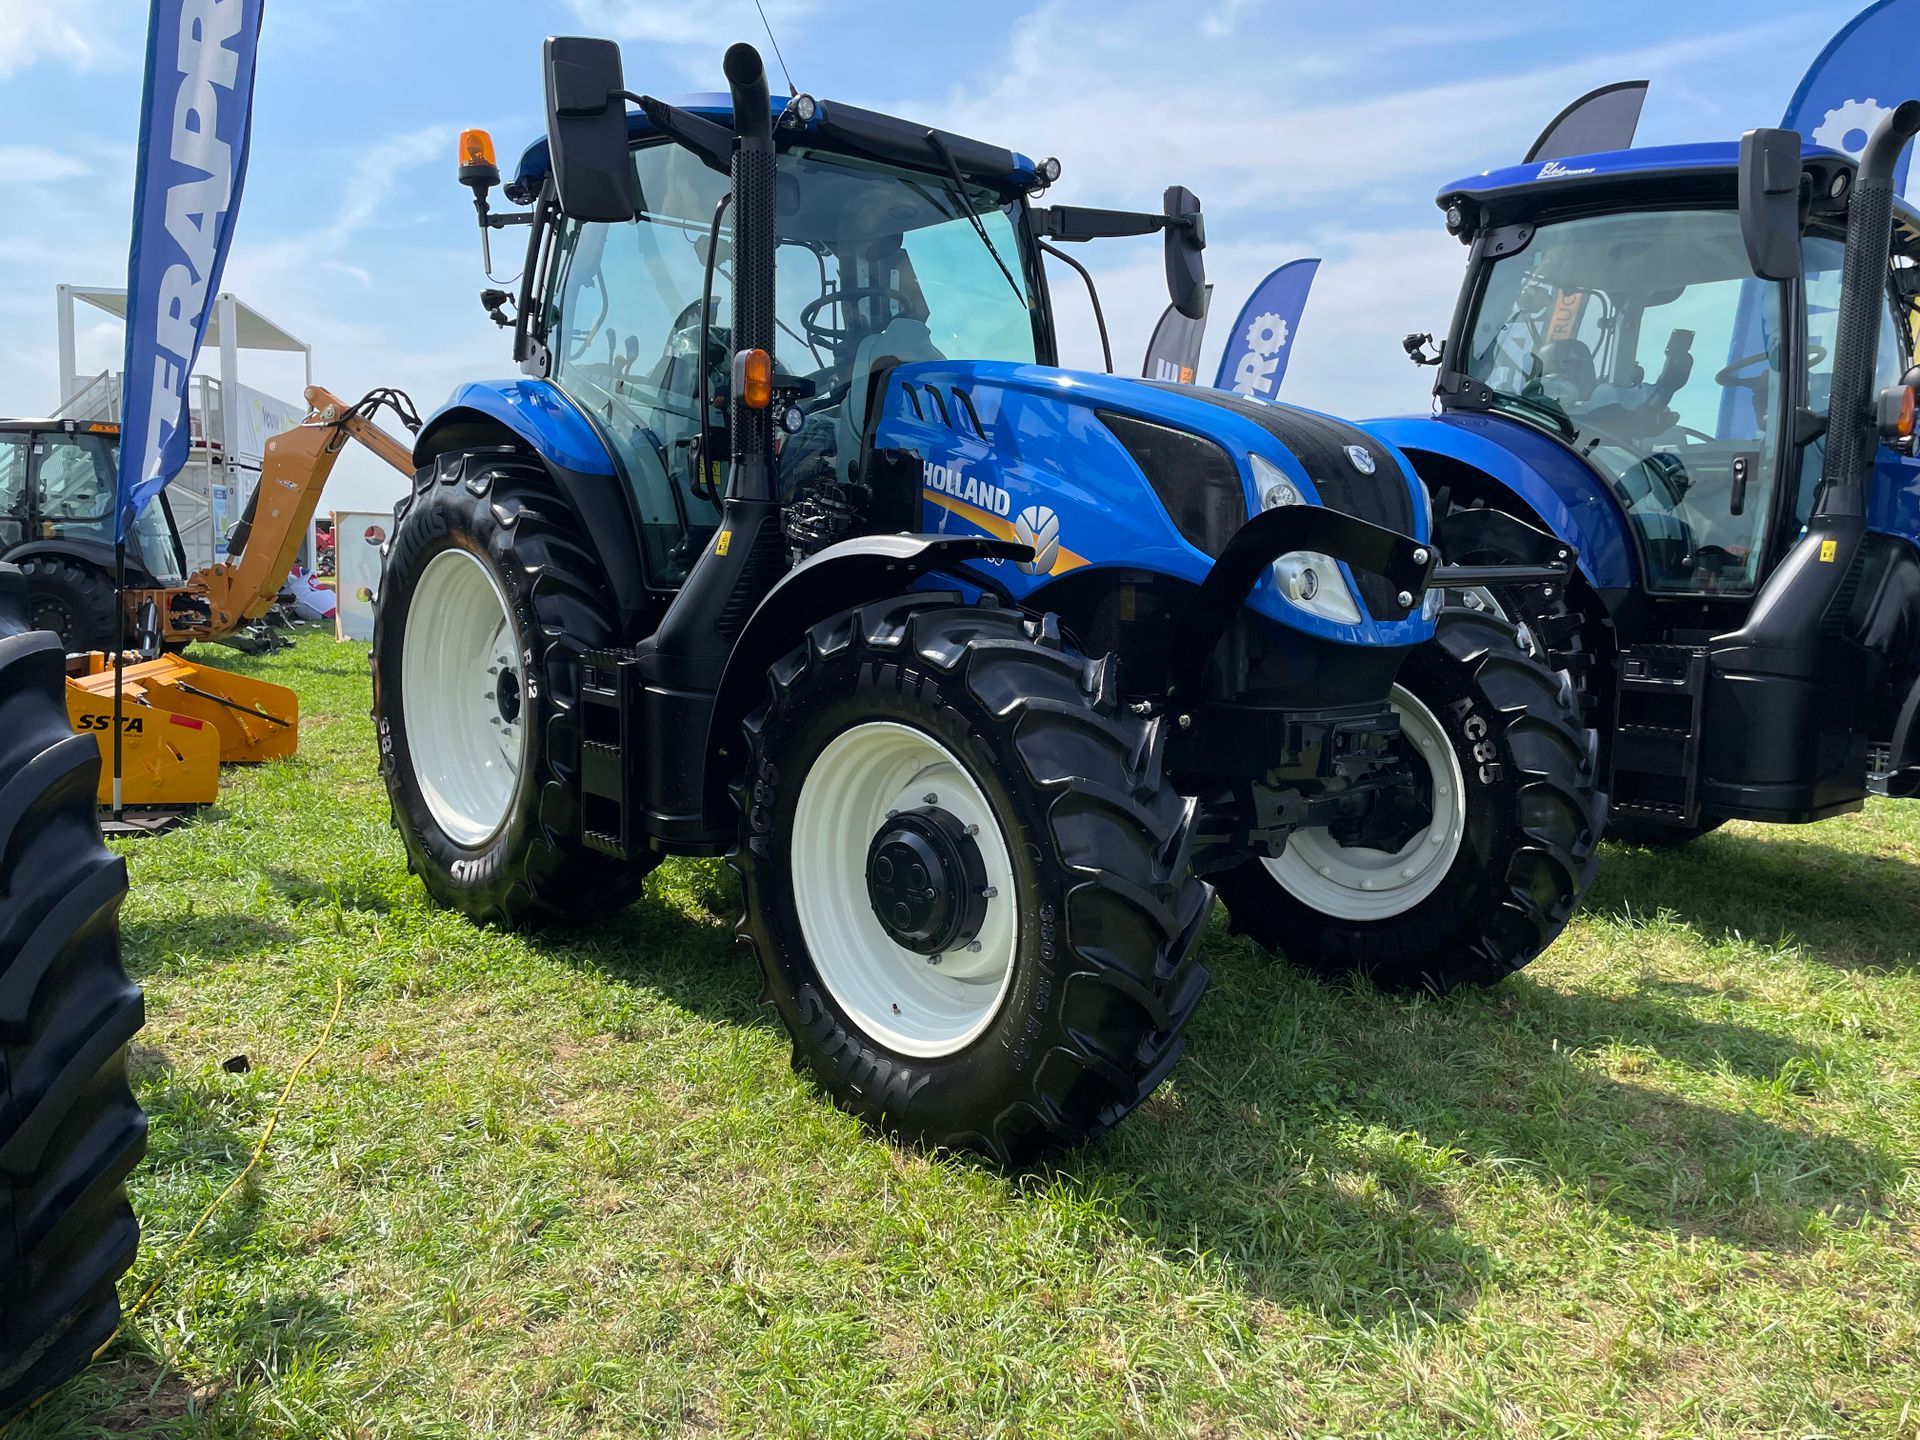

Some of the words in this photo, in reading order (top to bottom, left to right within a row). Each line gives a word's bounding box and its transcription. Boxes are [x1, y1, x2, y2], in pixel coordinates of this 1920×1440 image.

[923, 461, 1011, 517] HOLLAND
[378, 717, 401, 791] AC85
[1447, 696, 1504, 785] AC85
[749, 757, 780, 859] AC85
